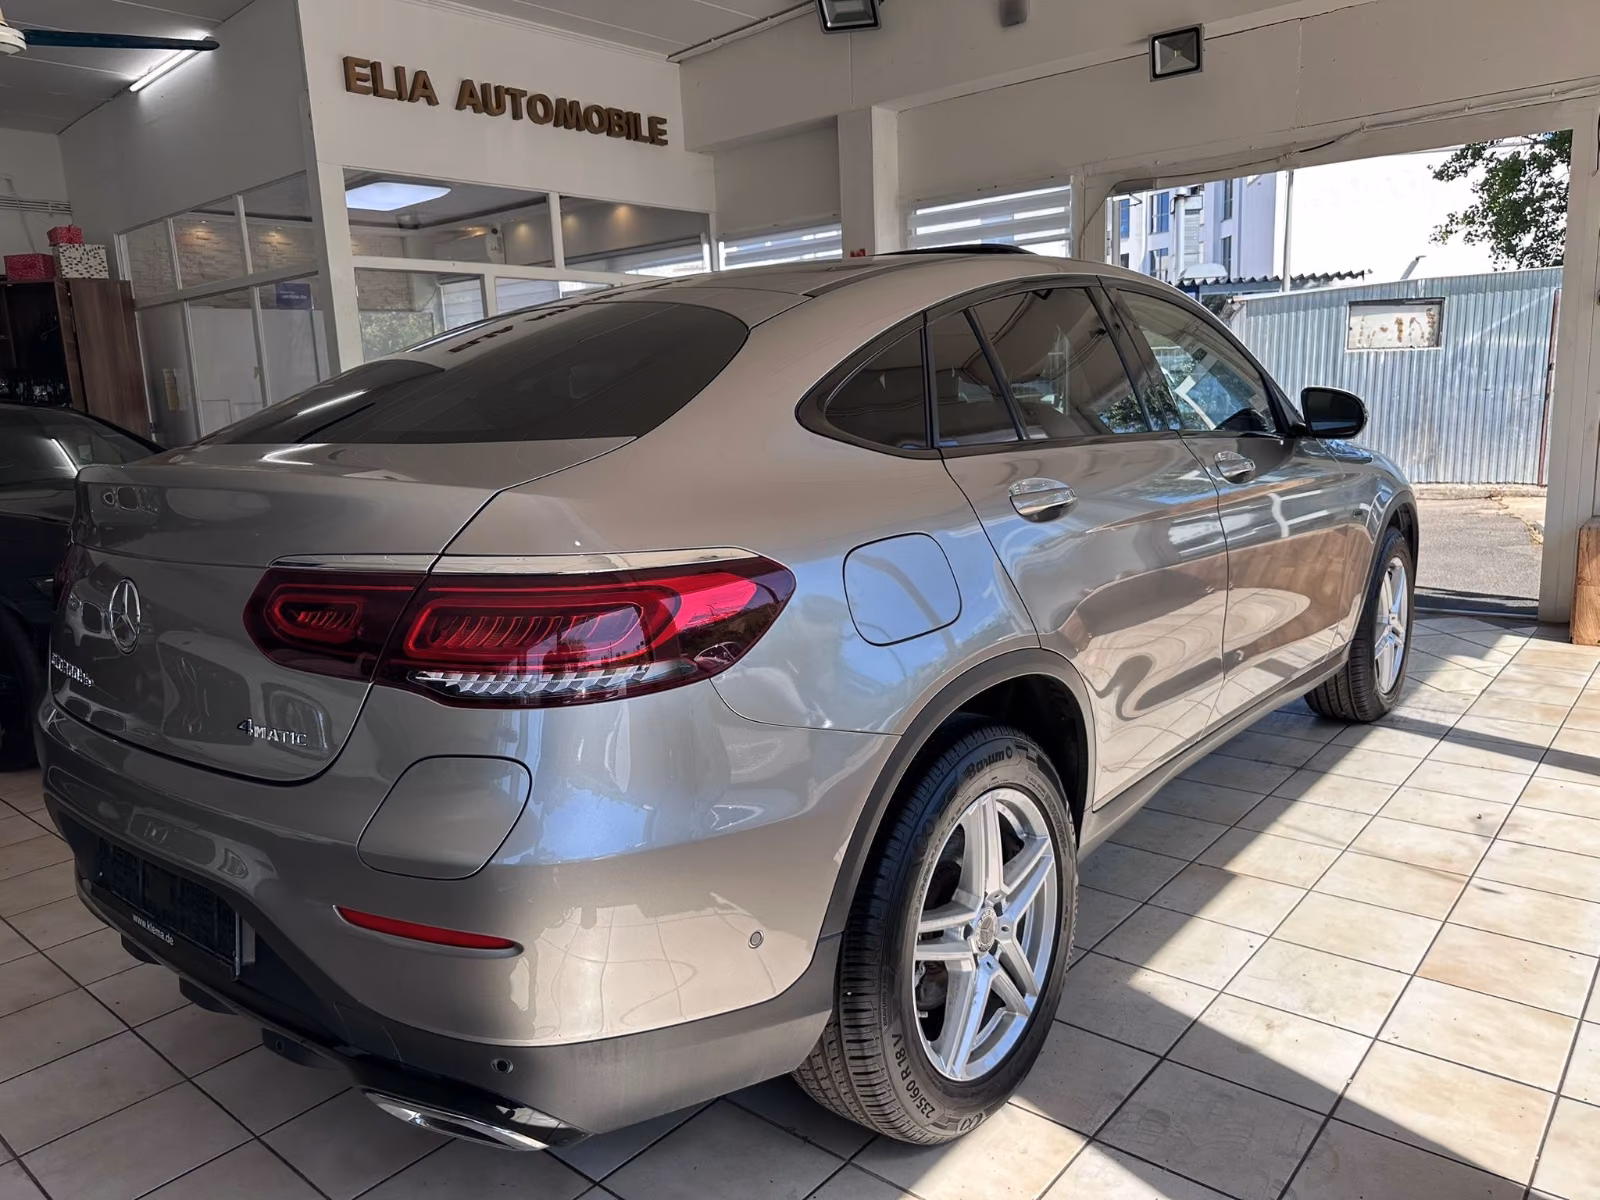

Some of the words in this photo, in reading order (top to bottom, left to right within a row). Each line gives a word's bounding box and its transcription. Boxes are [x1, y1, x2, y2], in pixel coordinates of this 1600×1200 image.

[343, 56, 439, 106] ELIA
[455, 79, 668, 146] AUTOMOBILE
[237, 718, 307, 746] 4MATIC
[892, 1033, 902, 1047] V
[895, 1048, 907, 1067] 18
[901, 1065, 911, 1081] R
[906, 1080, 936, 1119] 235/60
